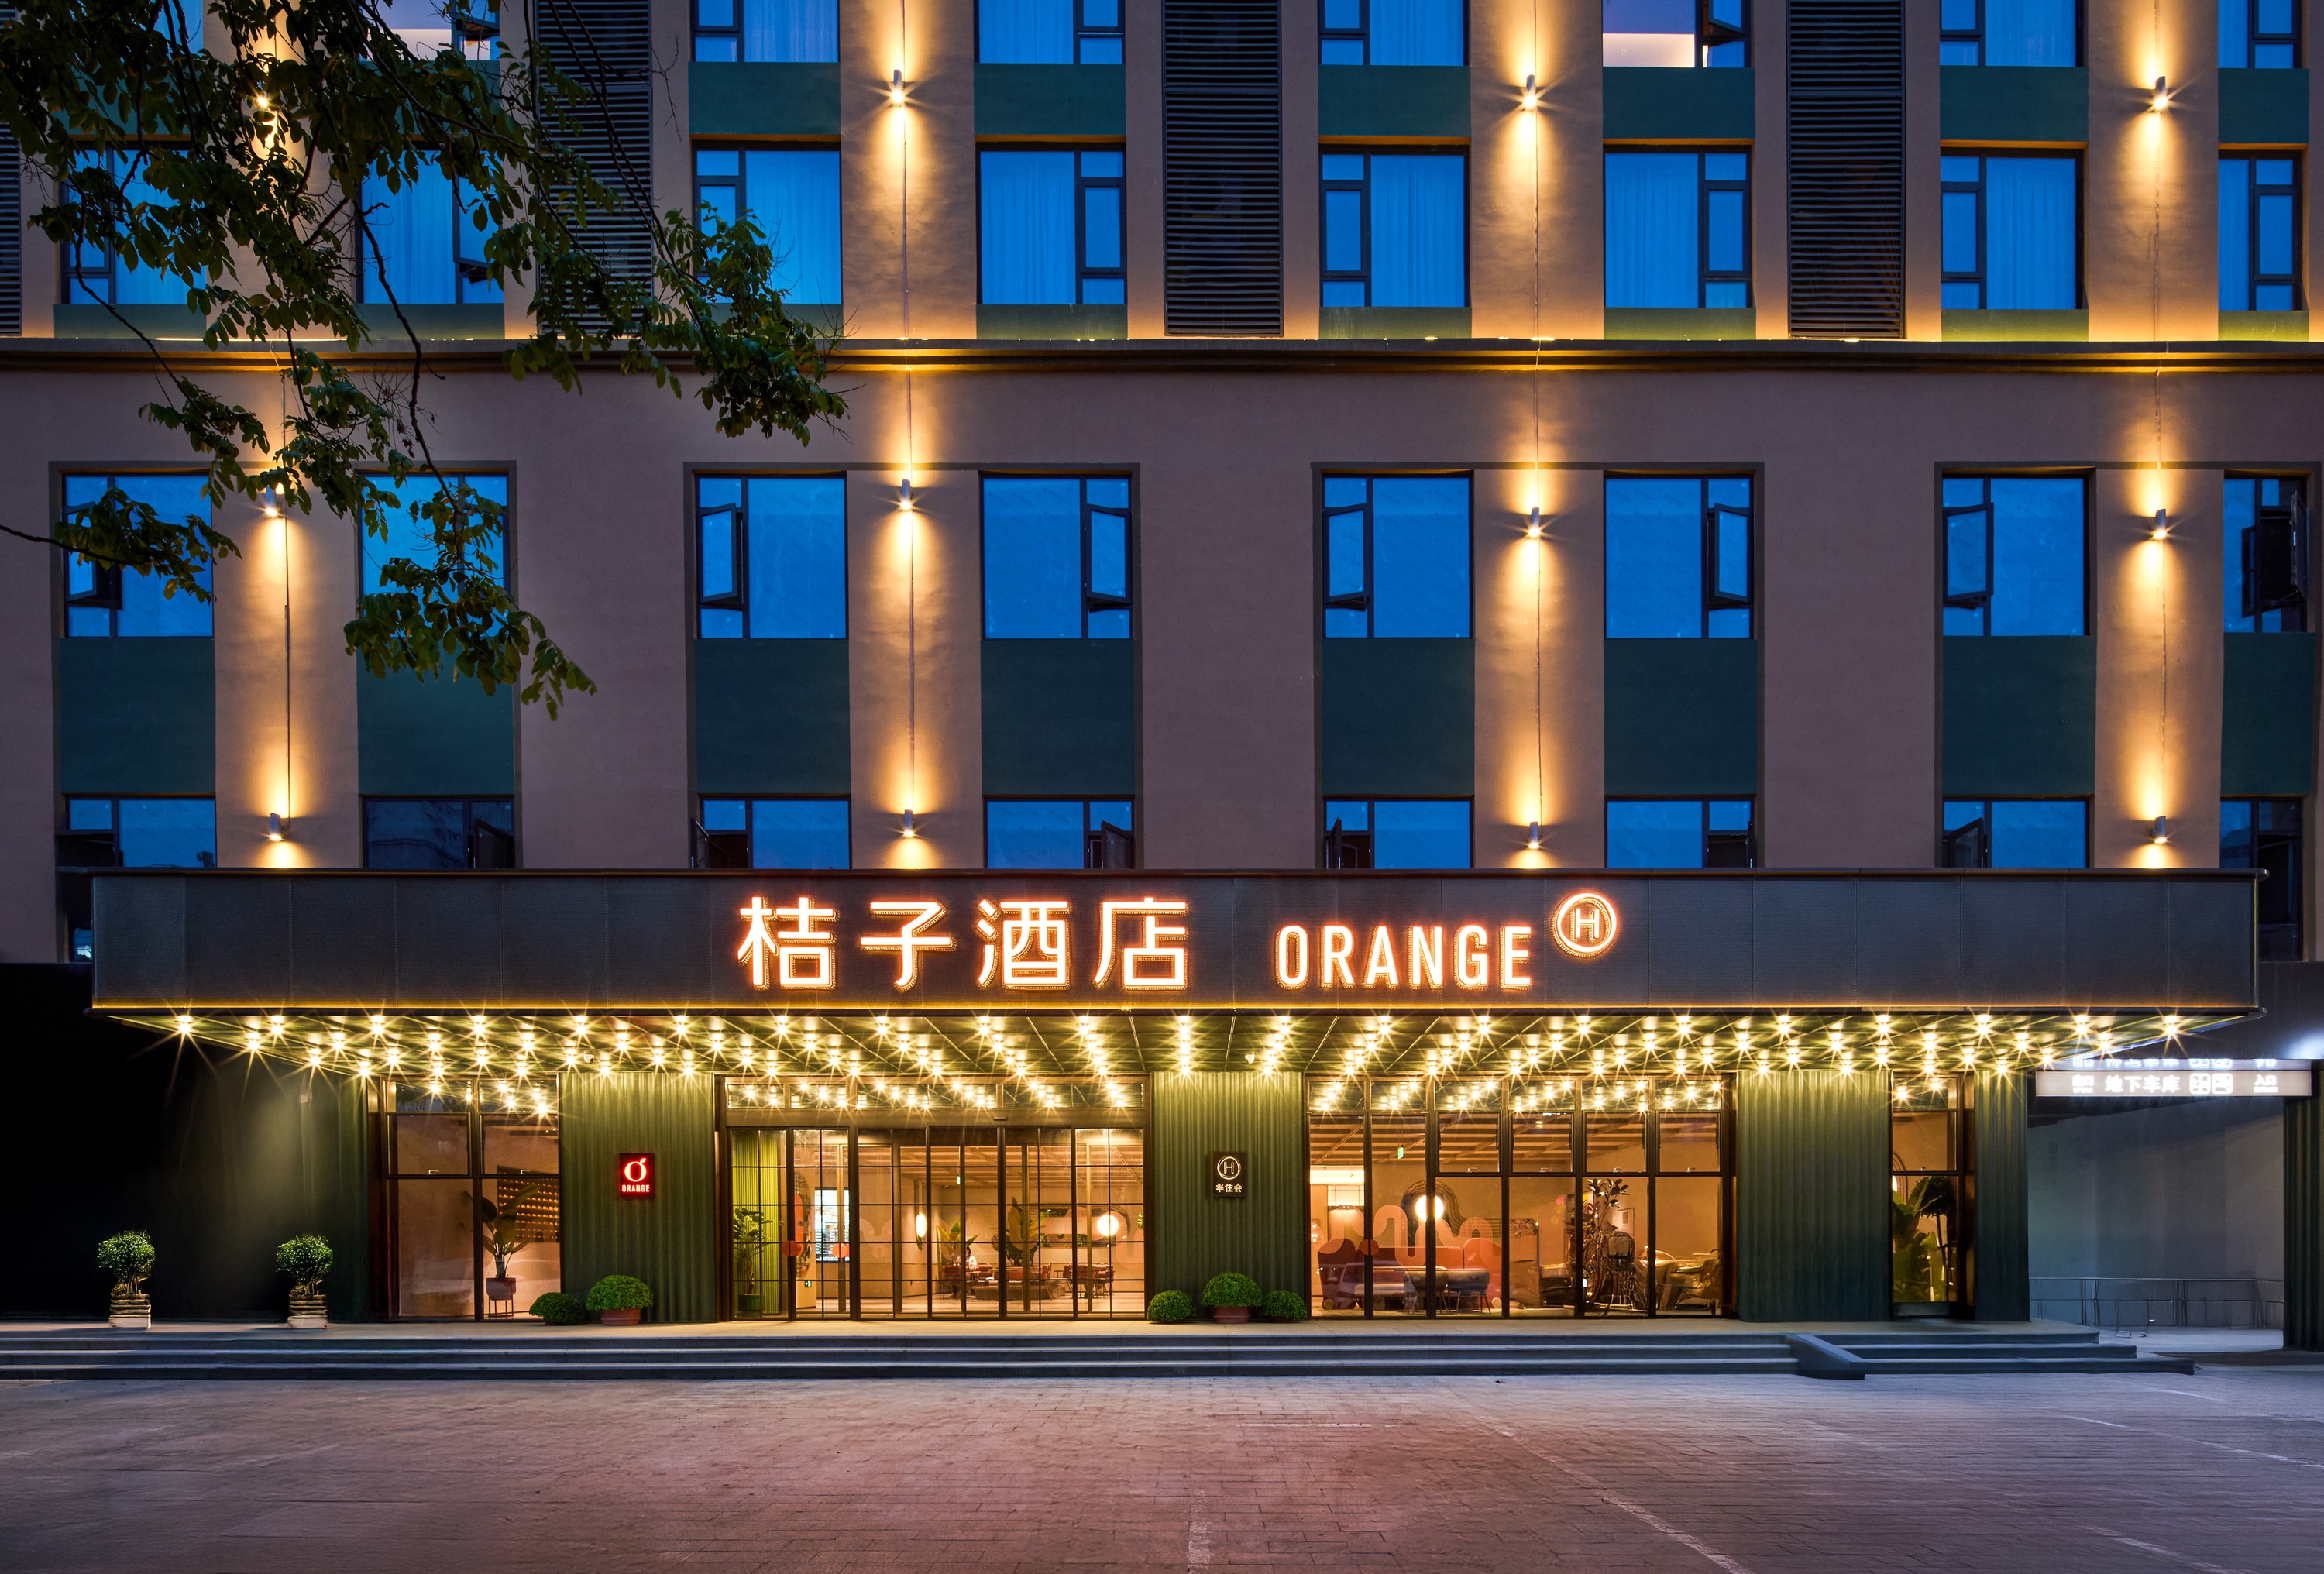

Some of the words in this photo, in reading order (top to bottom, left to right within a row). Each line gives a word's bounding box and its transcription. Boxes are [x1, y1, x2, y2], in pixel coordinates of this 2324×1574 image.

[738, 896, 1187, 986] 桔子酒店
[1277, 924, 1532, 986] ORANGE
[2105, 1074, 2180, 1093] 地下车库
[2254, 1074, 2277, 1086] 入口
[1215, 1183, 1243, 1193] 华住会
